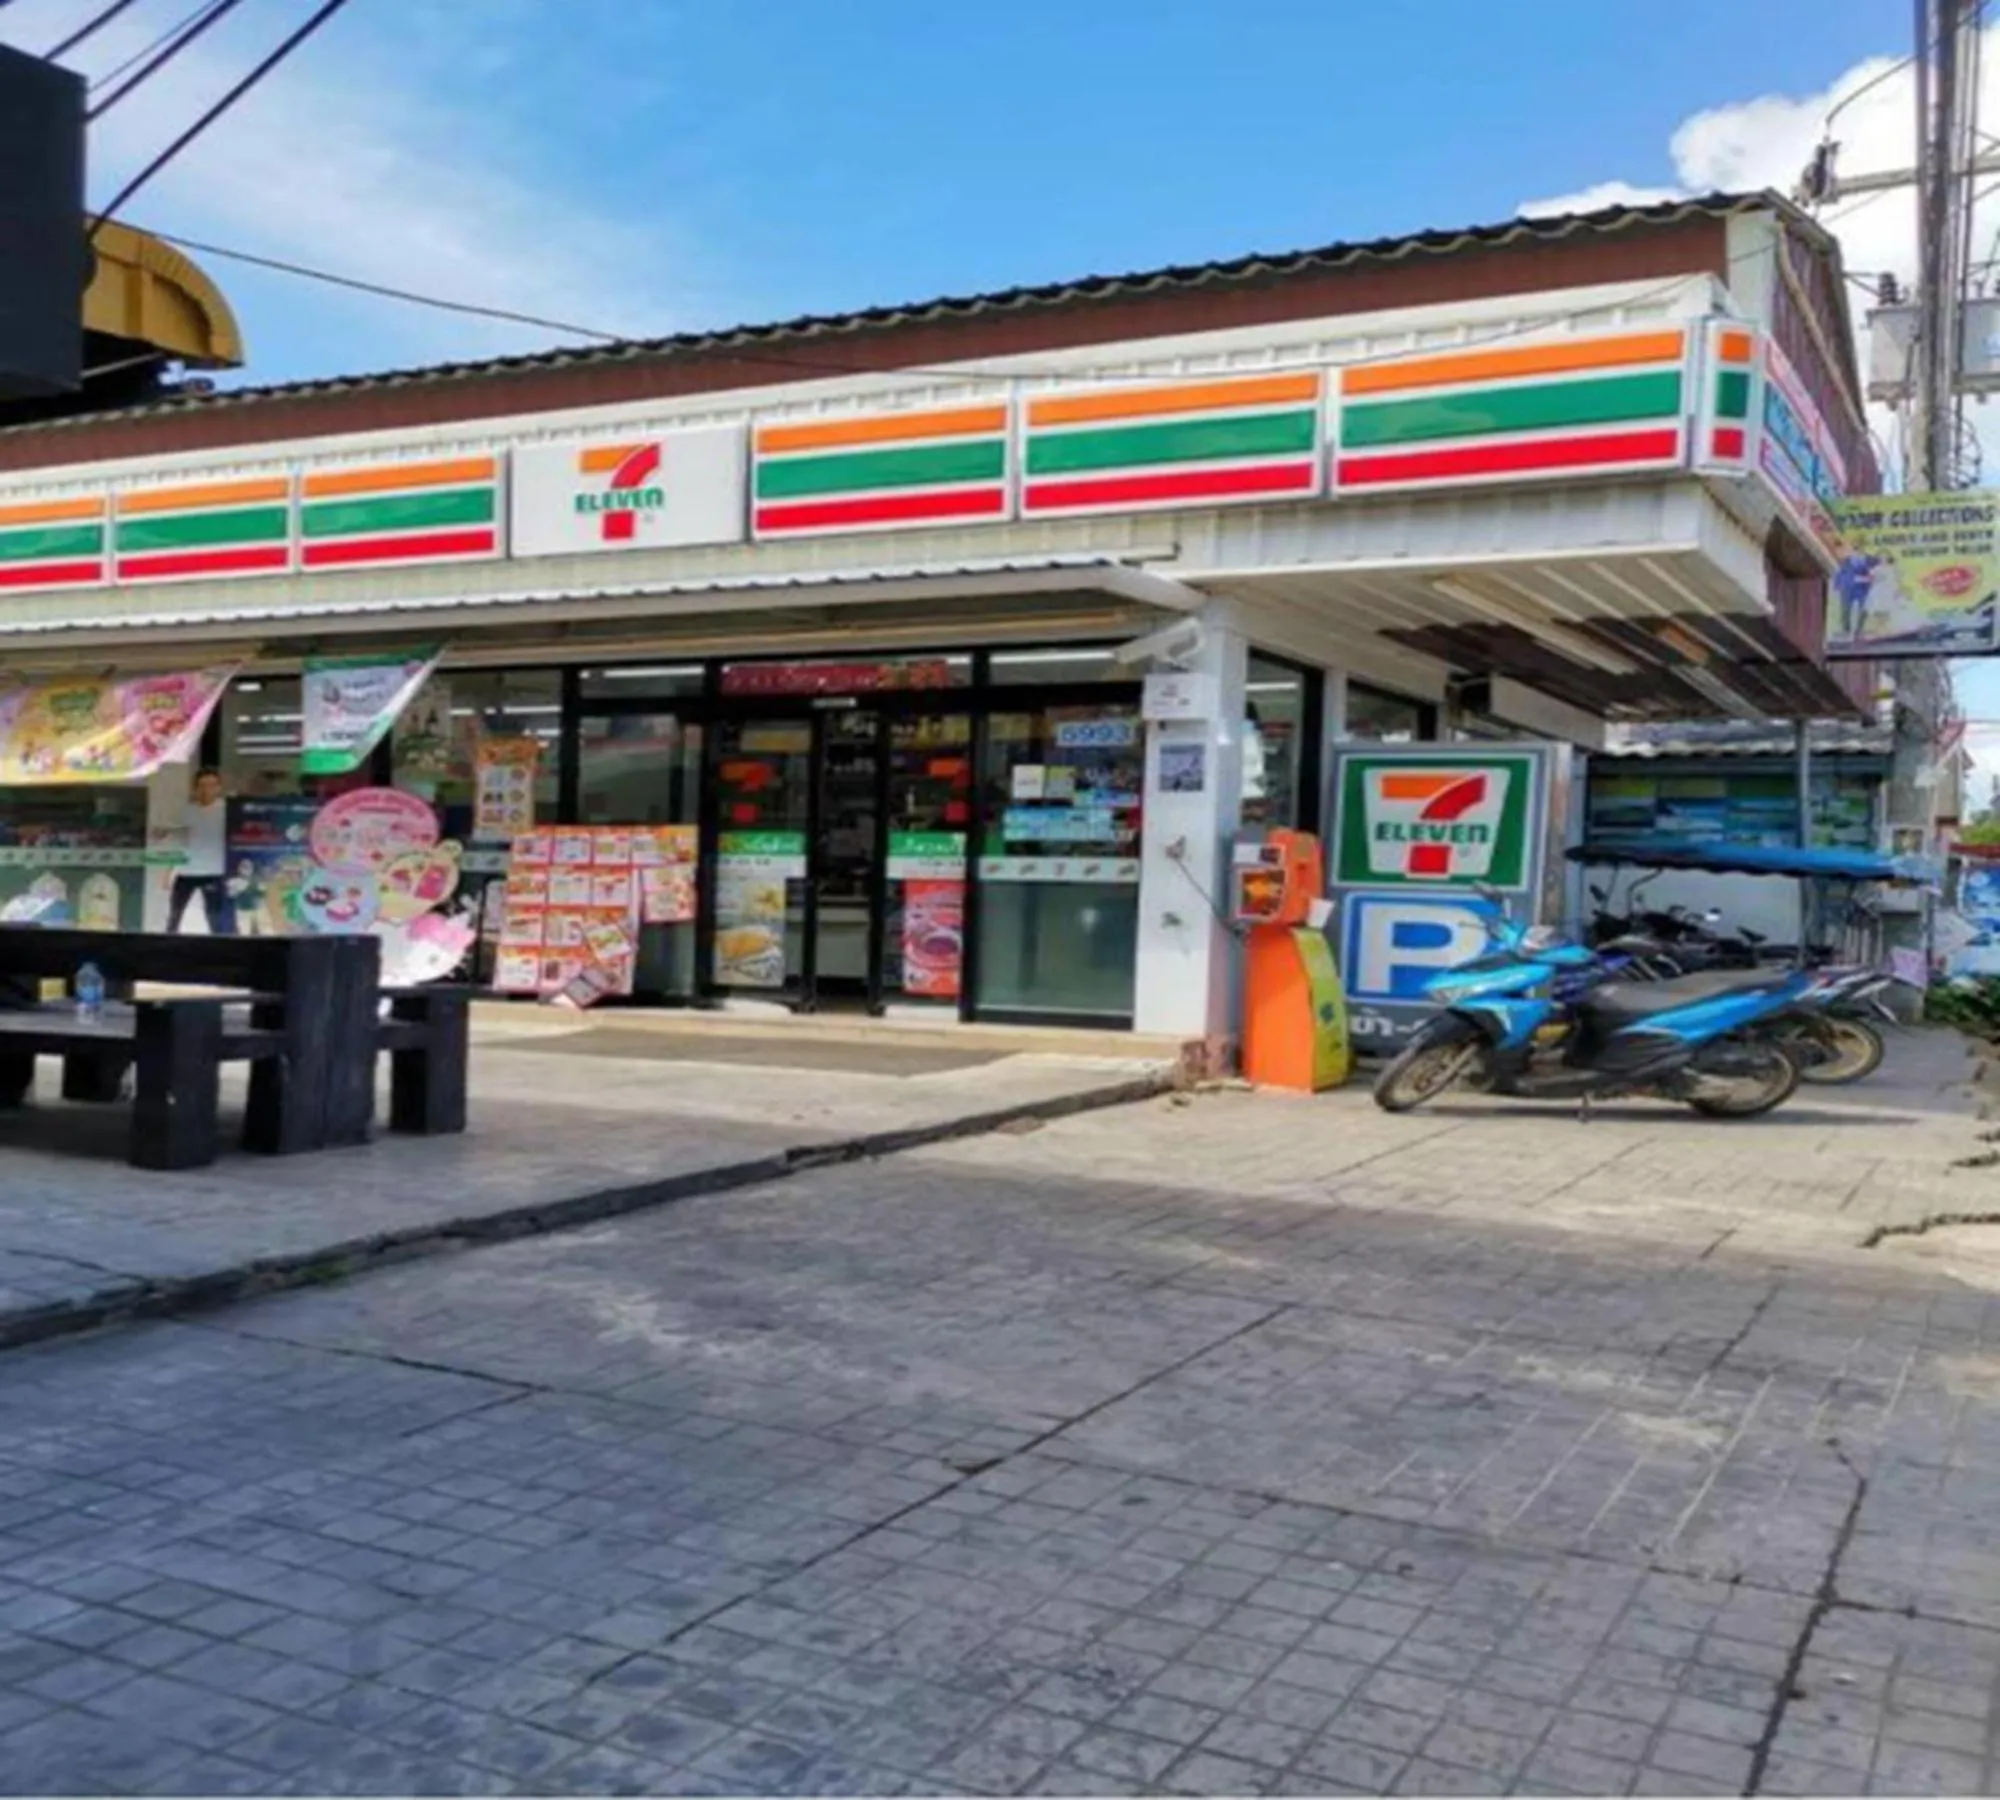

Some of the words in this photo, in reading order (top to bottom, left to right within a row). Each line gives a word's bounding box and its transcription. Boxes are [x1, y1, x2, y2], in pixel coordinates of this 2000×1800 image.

[579, 442, 661, 540] 7
[1382, 775, 1486, 874] 7
[1358, 903, 1486, 993] P
